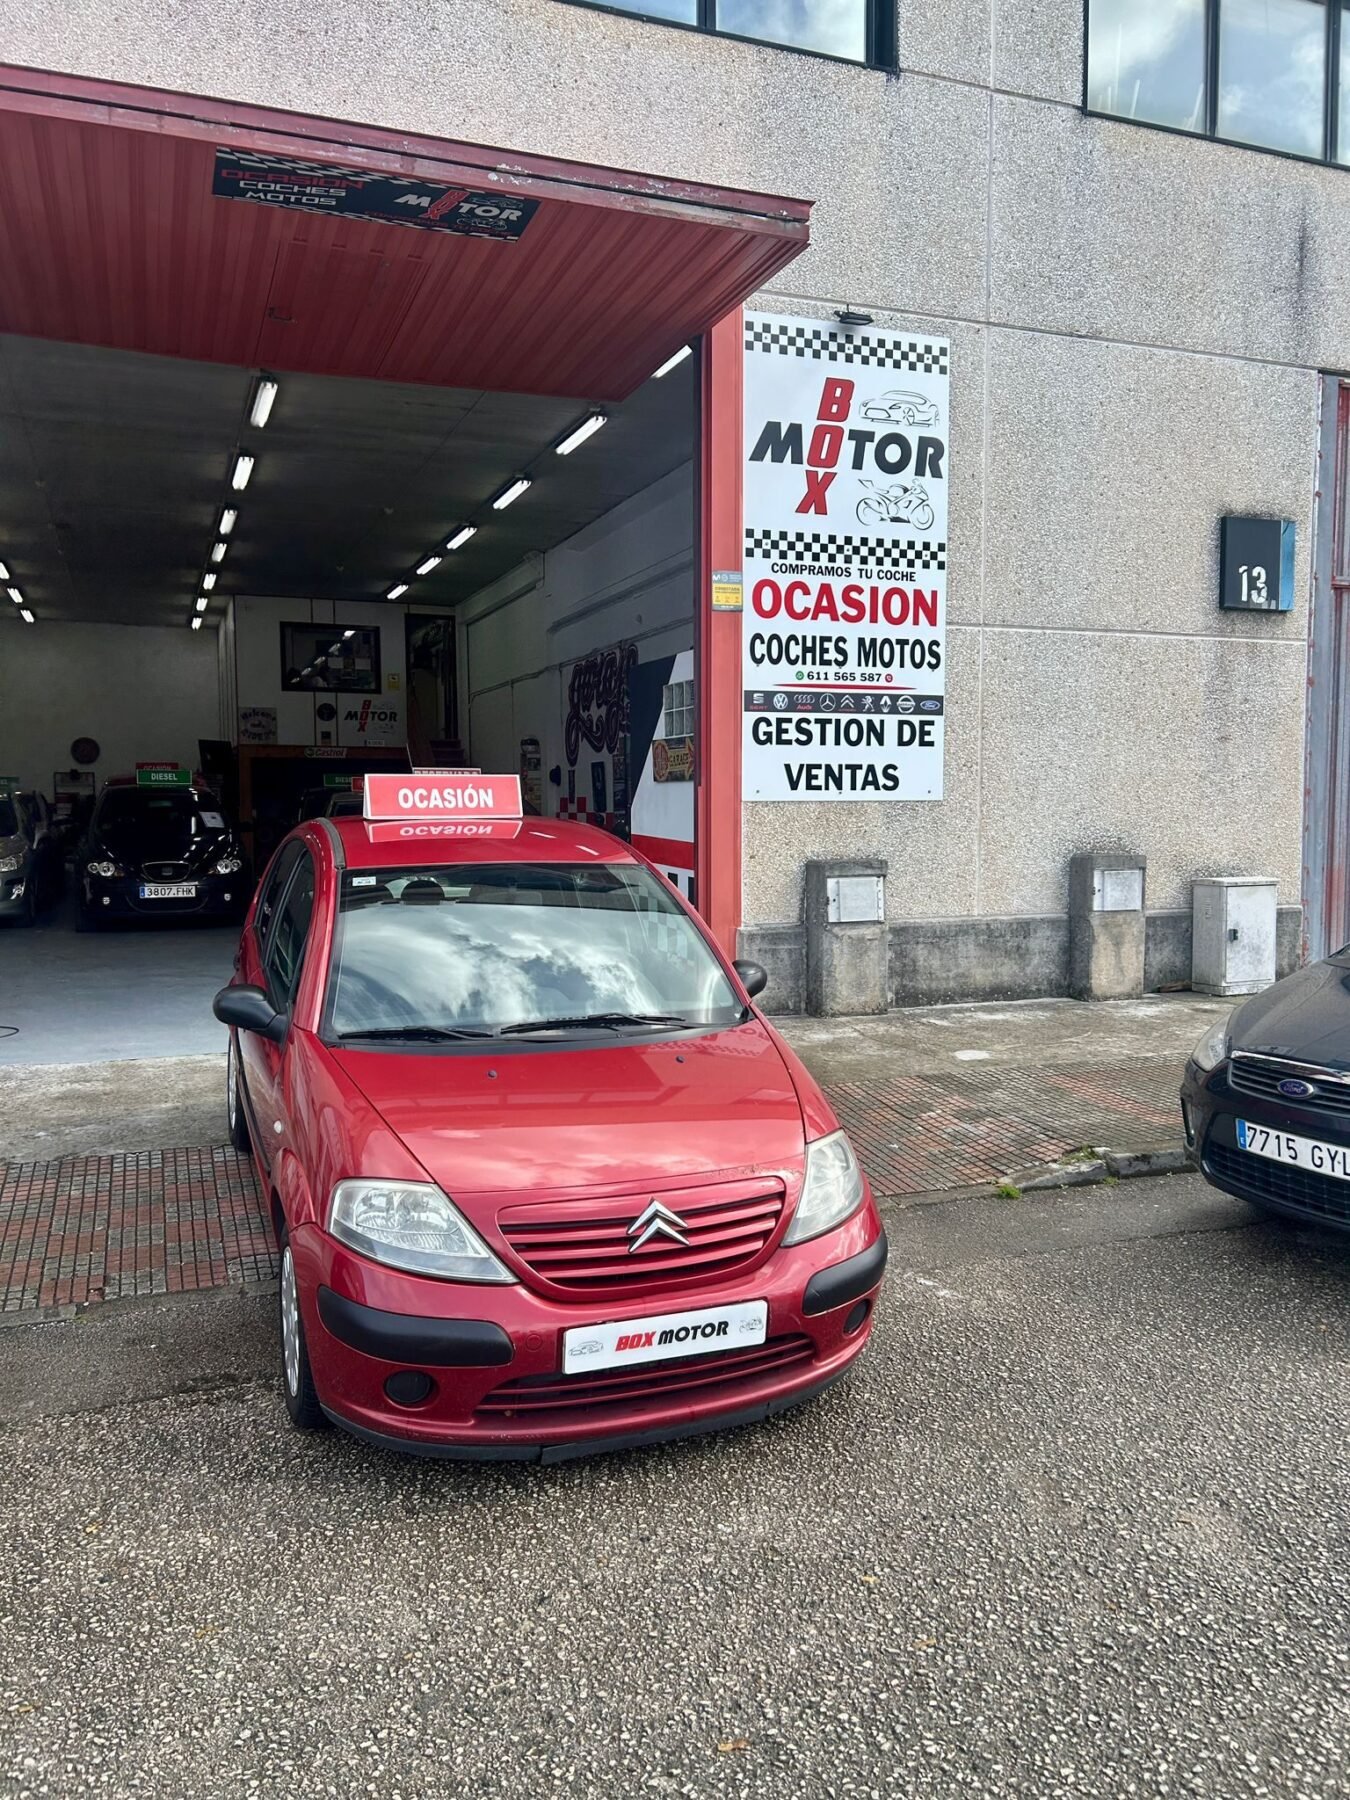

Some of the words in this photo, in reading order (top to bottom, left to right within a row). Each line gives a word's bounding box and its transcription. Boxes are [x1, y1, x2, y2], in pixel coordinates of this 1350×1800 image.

[220, 168, 365, 191] OCASION
[239, 180, 346, 197] COCHES
[244, 190, 337, 206] MOTOS
[795, 376, 855, 516] BOX
[770, 562, 852, 578] COMPRAMOS
[857, 568, 873, 580] TU
[876, 569, 917, 582] COCHE
[1238, 565, 1268, 604] 13
[751, 578, 938, 627] OCASION
[750, 632, 848, 668] COCHES
[857, 636, 941, 670] MOTOS
[806, 670, 830, 681] 611
[833, 671, 856, 682] 565
[859, 672, 882, 683] 587
[751, 716, 885, 747] GESTION
[897, 719, 935, 747] DE
[151, 772, 178, 781] DIESEL
[783, 763, 900, 792] VENTAS
[397, 783, 494, 809] OCASIÓN
[1246, 1125, 1298, 1161] 7715
[1310, 1144, 1350, 1177] GYL
[614, 1330, 657, 1353] BOX
[657, 1320, 729, 1346] MOTOR
